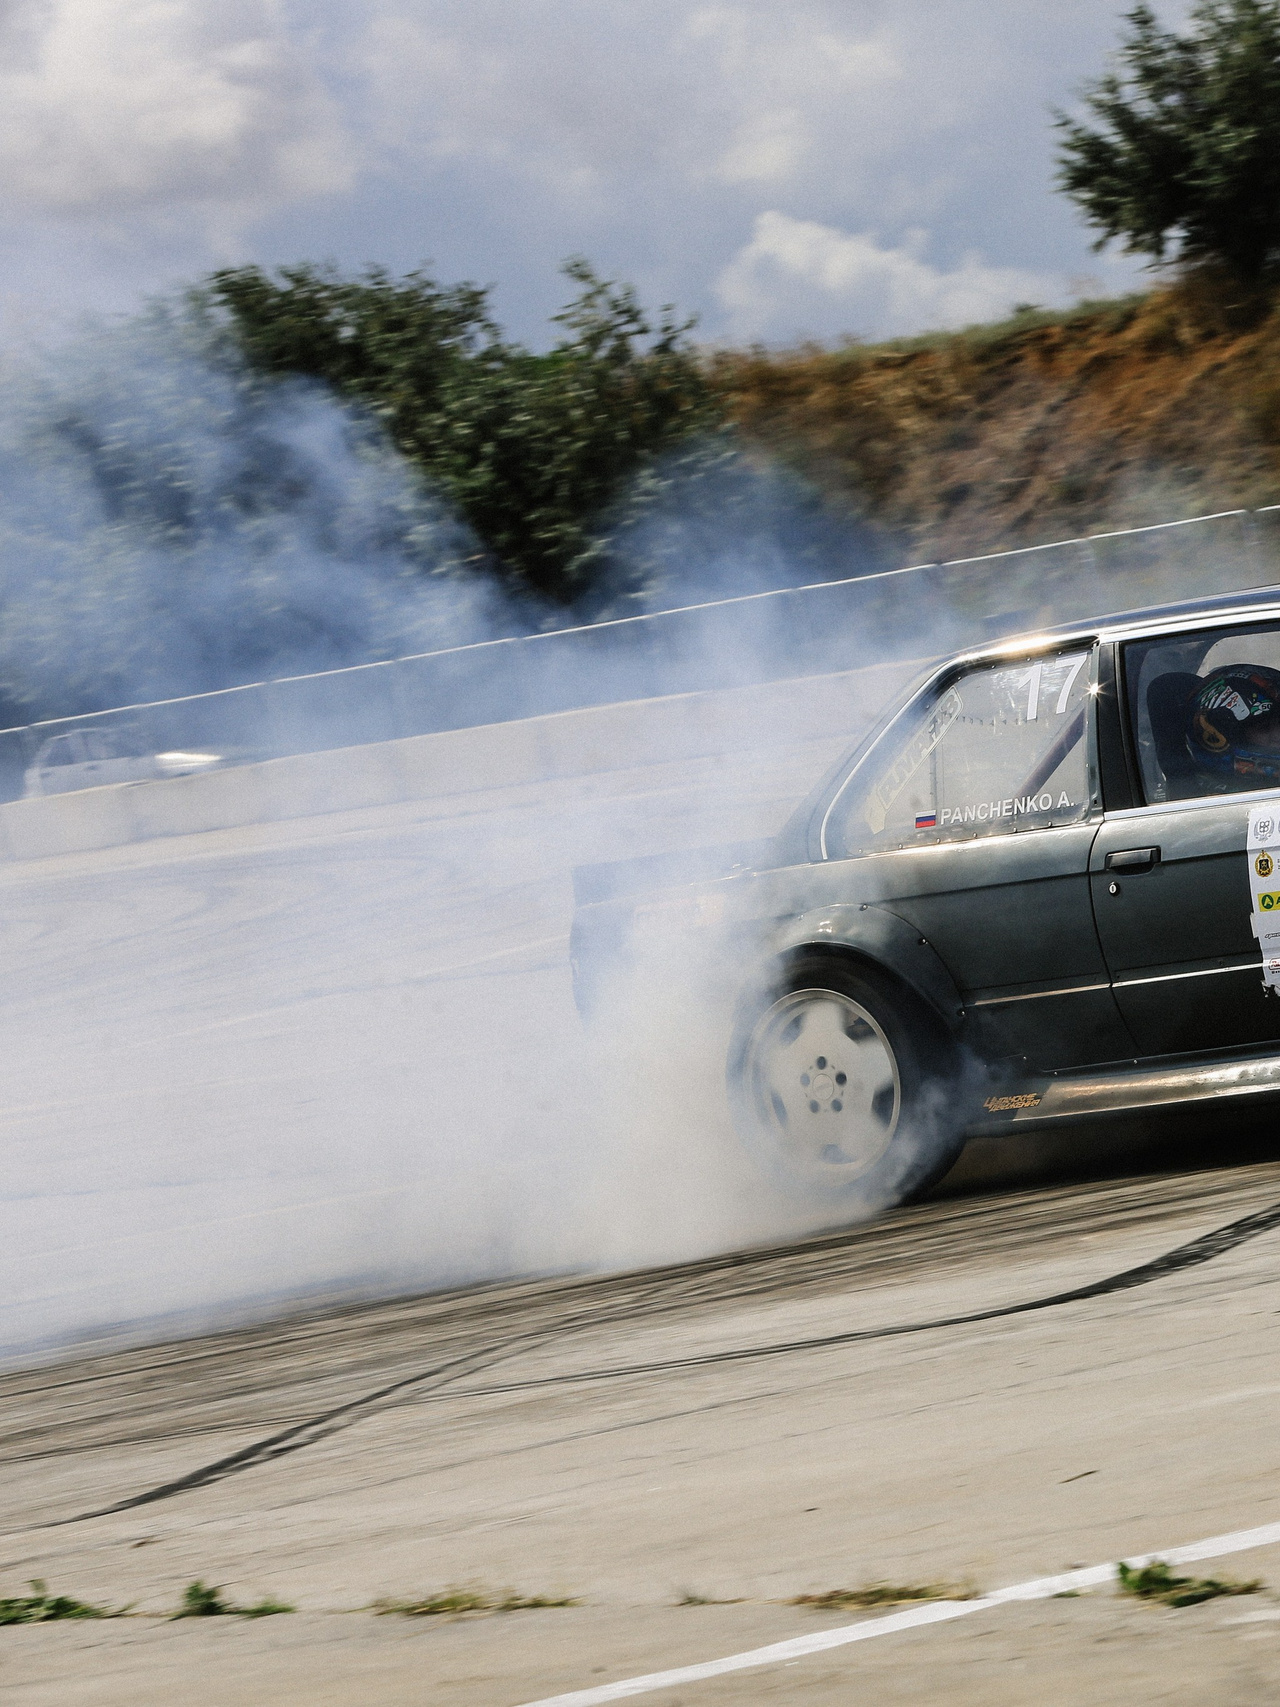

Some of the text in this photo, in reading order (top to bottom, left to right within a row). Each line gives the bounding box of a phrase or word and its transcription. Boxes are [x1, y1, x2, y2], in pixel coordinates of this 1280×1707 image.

[1018, 651, 1088, 721] 17
[940, 790, 1075, 825] PANCHENKO A.
